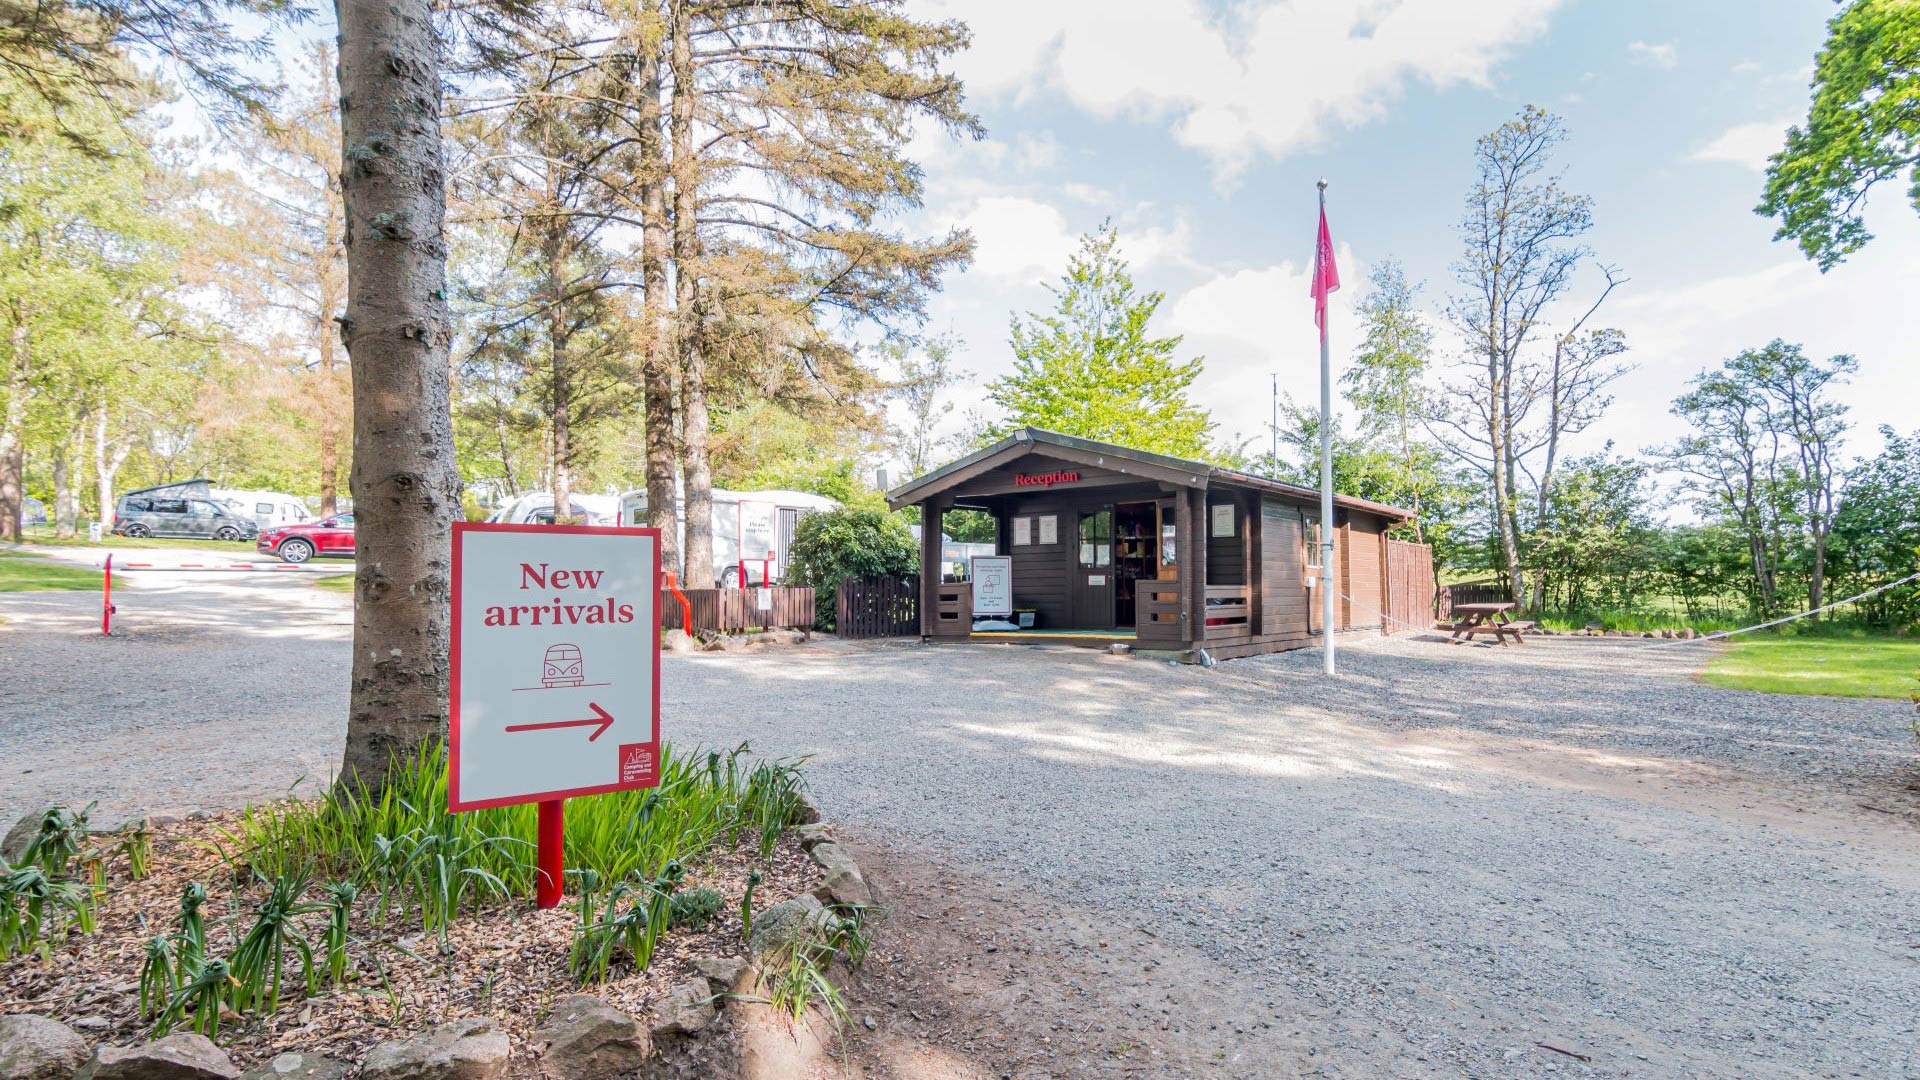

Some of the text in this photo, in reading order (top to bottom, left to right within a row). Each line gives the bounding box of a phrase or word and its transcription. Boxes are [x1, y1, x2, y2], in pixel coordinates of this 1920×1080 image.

[1015, 470, 1079, 487] Reception
[519, 563, 605, 590] New
[484, 597, 634, 627] arrivals
